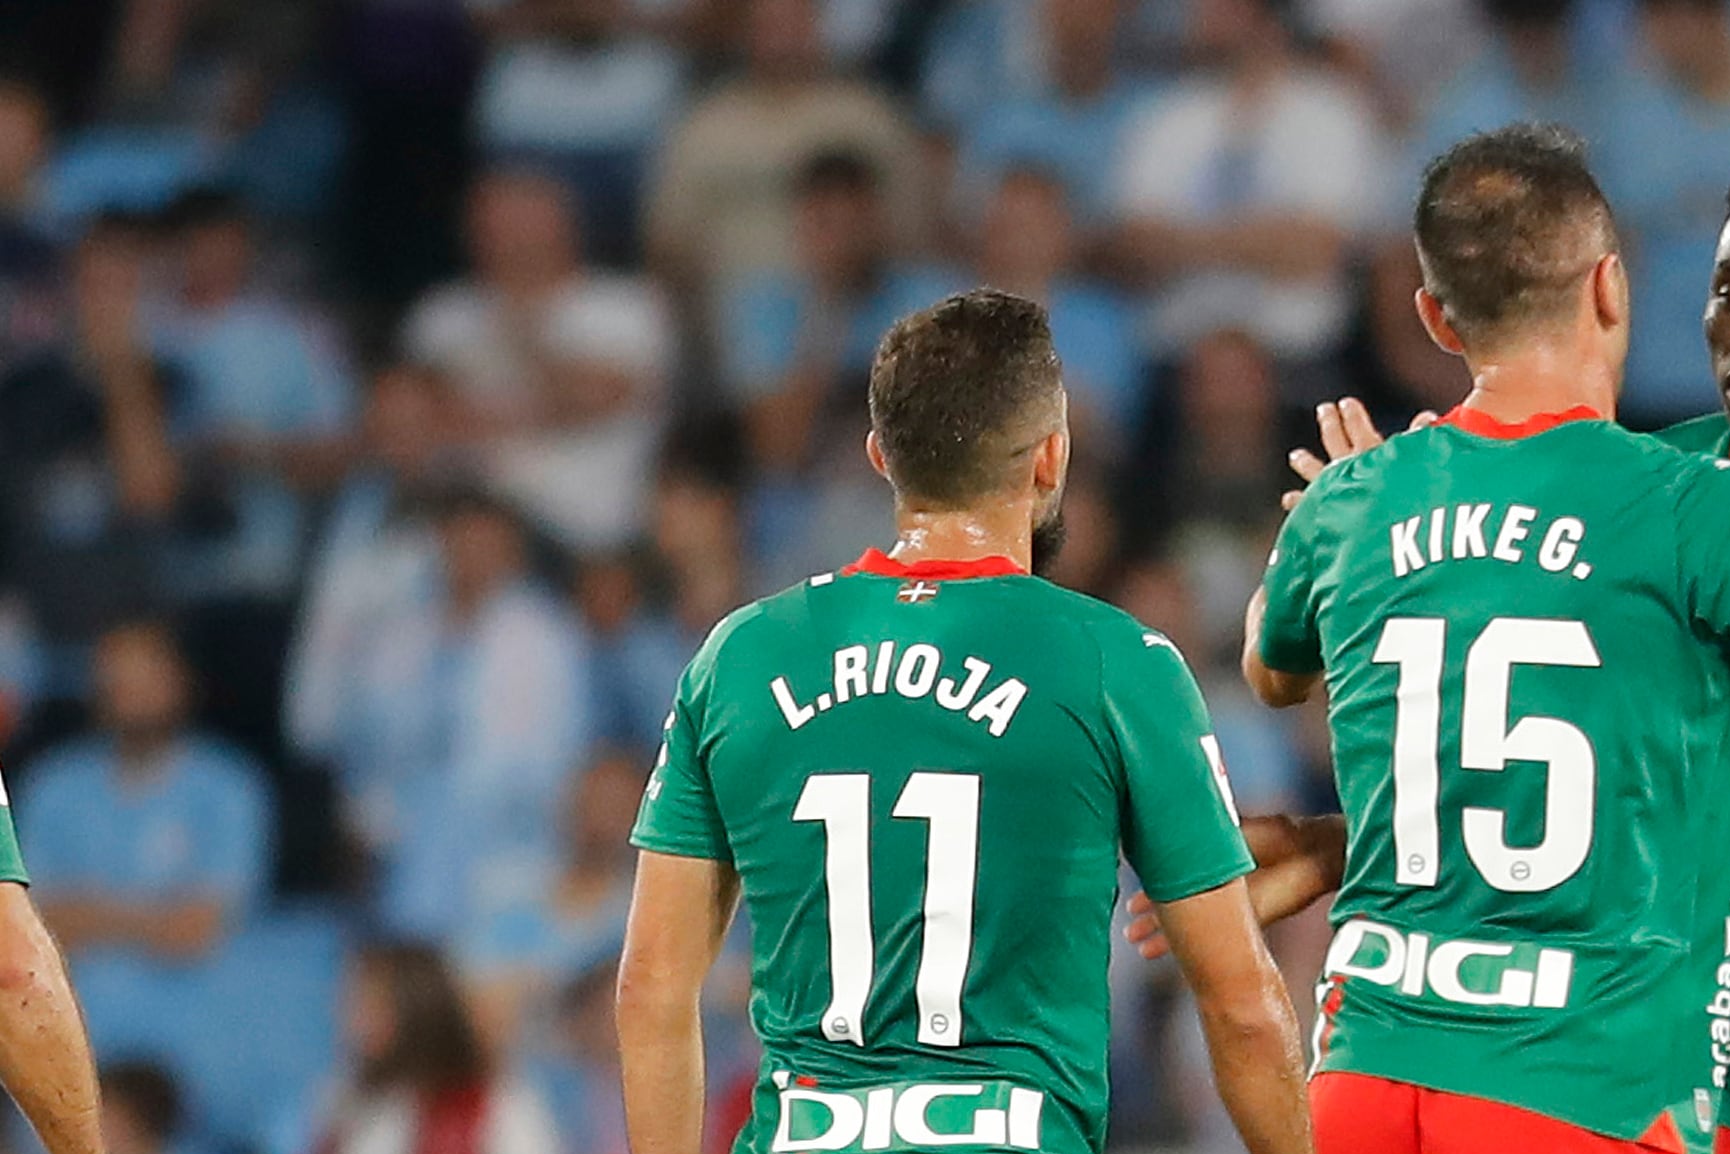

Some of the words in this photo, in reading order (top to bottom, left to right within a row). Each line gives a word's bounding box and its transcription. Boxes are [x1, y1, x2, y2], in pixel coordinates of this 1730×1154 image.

[1390, 503, 1538, 578] KIKE
[1539, 515, 1592, 581] G.
[769, 640, 1029, 737] L.RIOJA
[1372, 617, 1601, 892] 15
[791, 771, 981, 1047] 11
[1325, 919, 1573, 1008] DIGI
[771, 1083, 1043, 1151] DIGI
